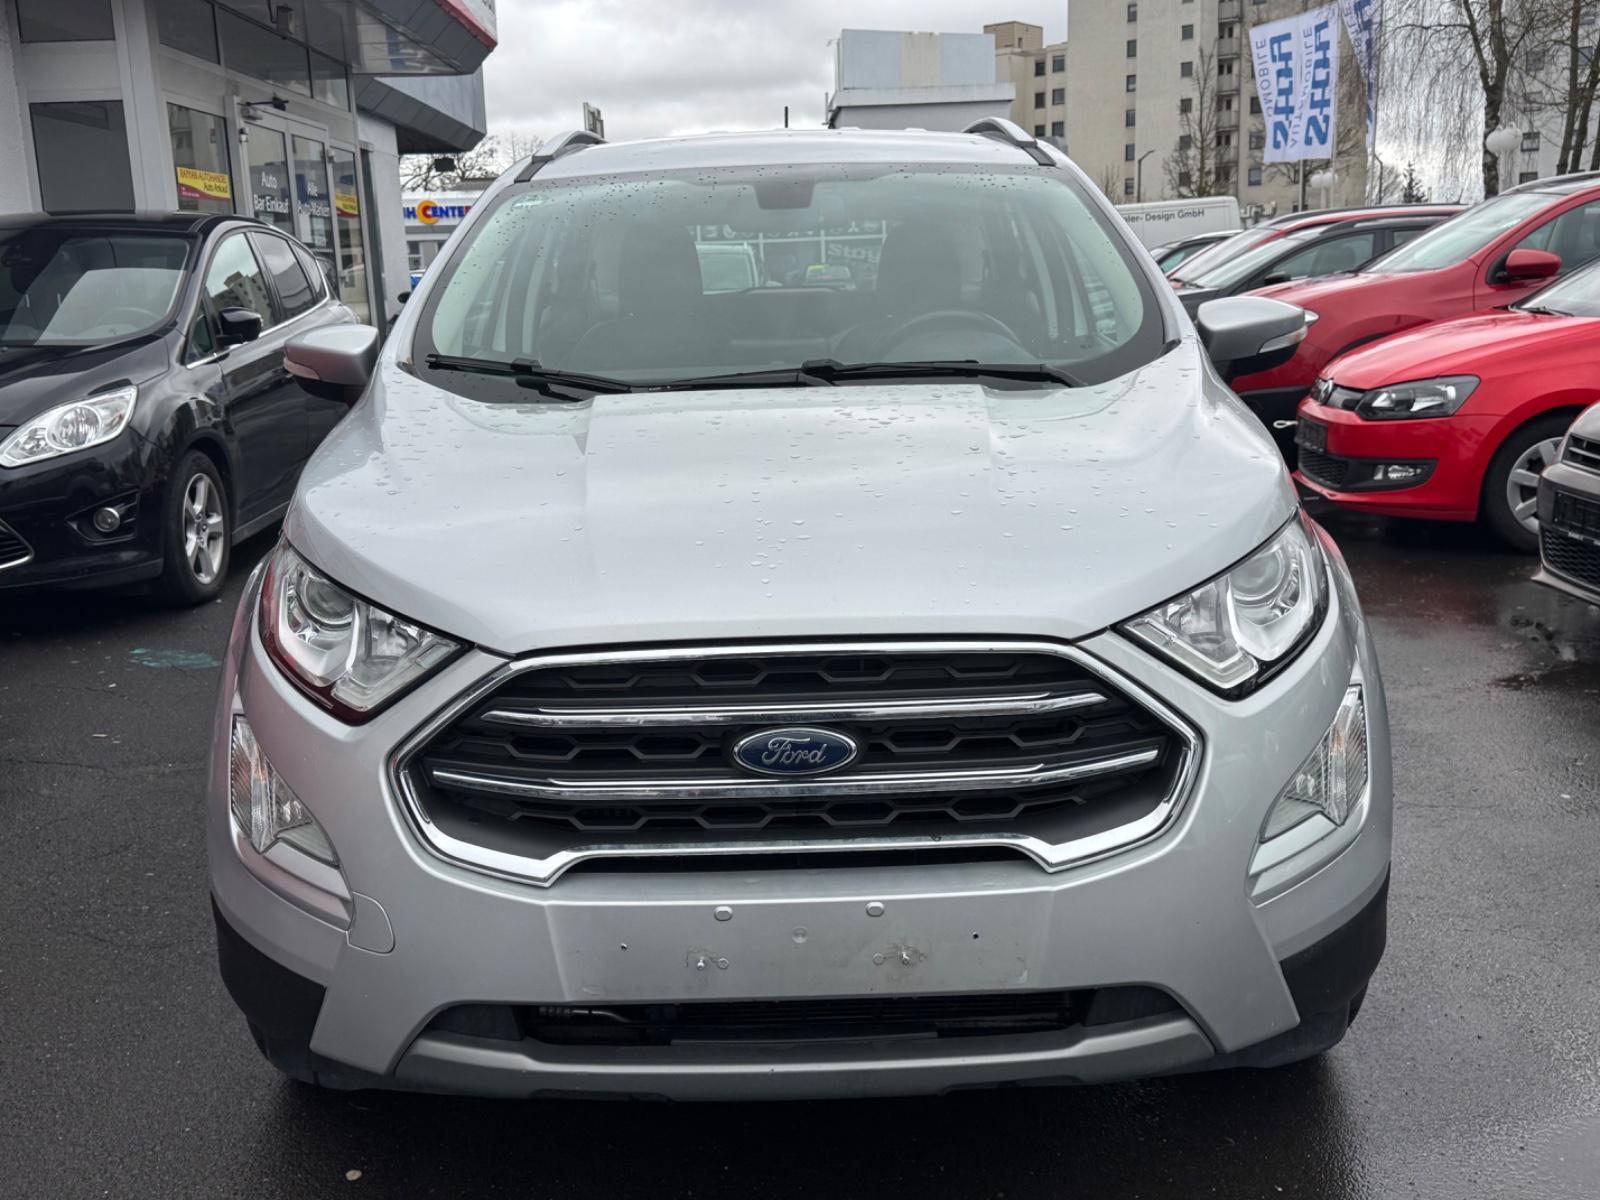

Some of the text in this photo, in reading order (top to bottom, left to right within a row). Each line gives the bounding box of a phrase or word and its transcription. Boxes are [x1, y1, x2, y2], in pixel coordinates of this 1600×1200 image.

[261, 171, 278, 189] Auto
[253, 193, 289, 213] Bar Einkauf
[1145, 212, 1176, 222] Design
[1177, 208, 1205, 219] GmbH
[761, 737, 828, 765] Ford
